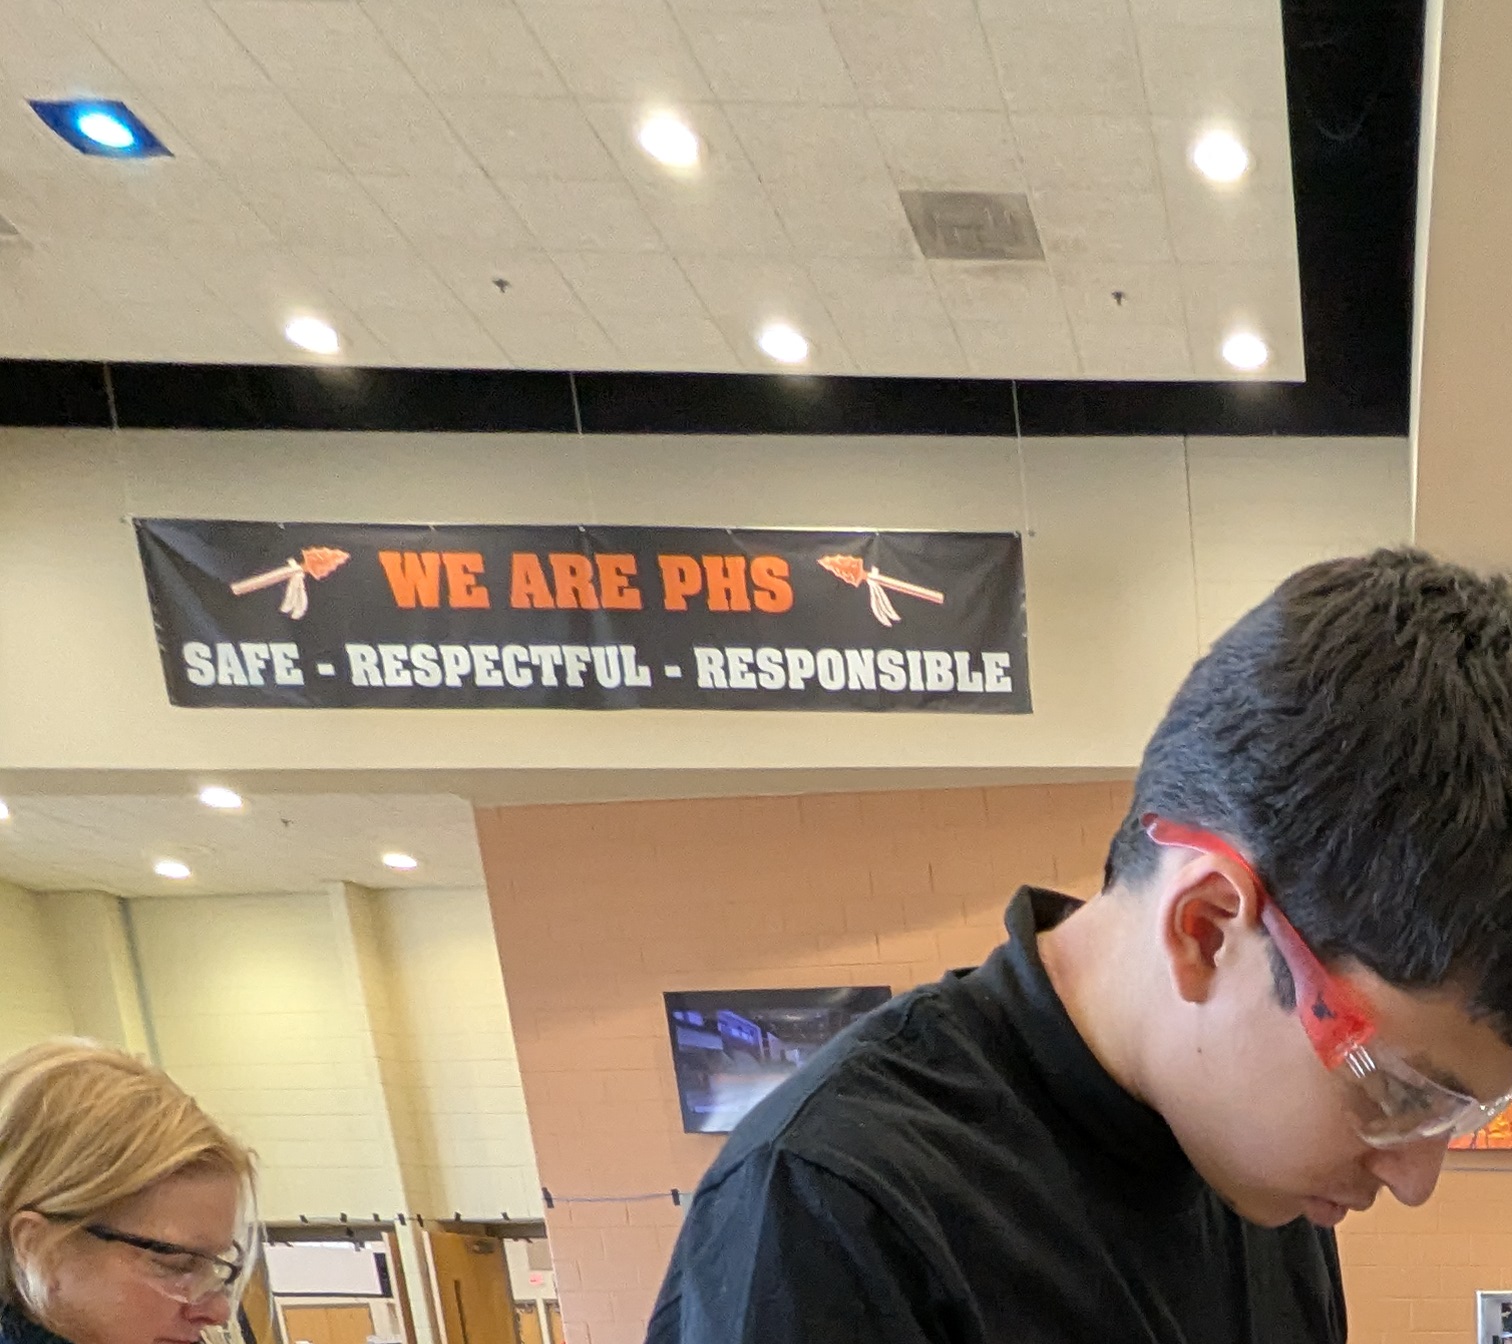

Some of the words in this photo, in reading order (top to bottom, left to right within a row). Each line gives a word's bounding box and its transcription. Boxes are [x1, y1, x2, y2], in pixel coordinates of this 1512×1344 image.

[379, 550, 491, 611] WE
[510, 552, 649, 612] ARE
[662, 553, 794, 614] PHS
[184, 643, 305, 688] SAFE
[350, 642, 652, 690] RESPECTFUL
[695, 647, 1013, 694] RESPONSIBLE
